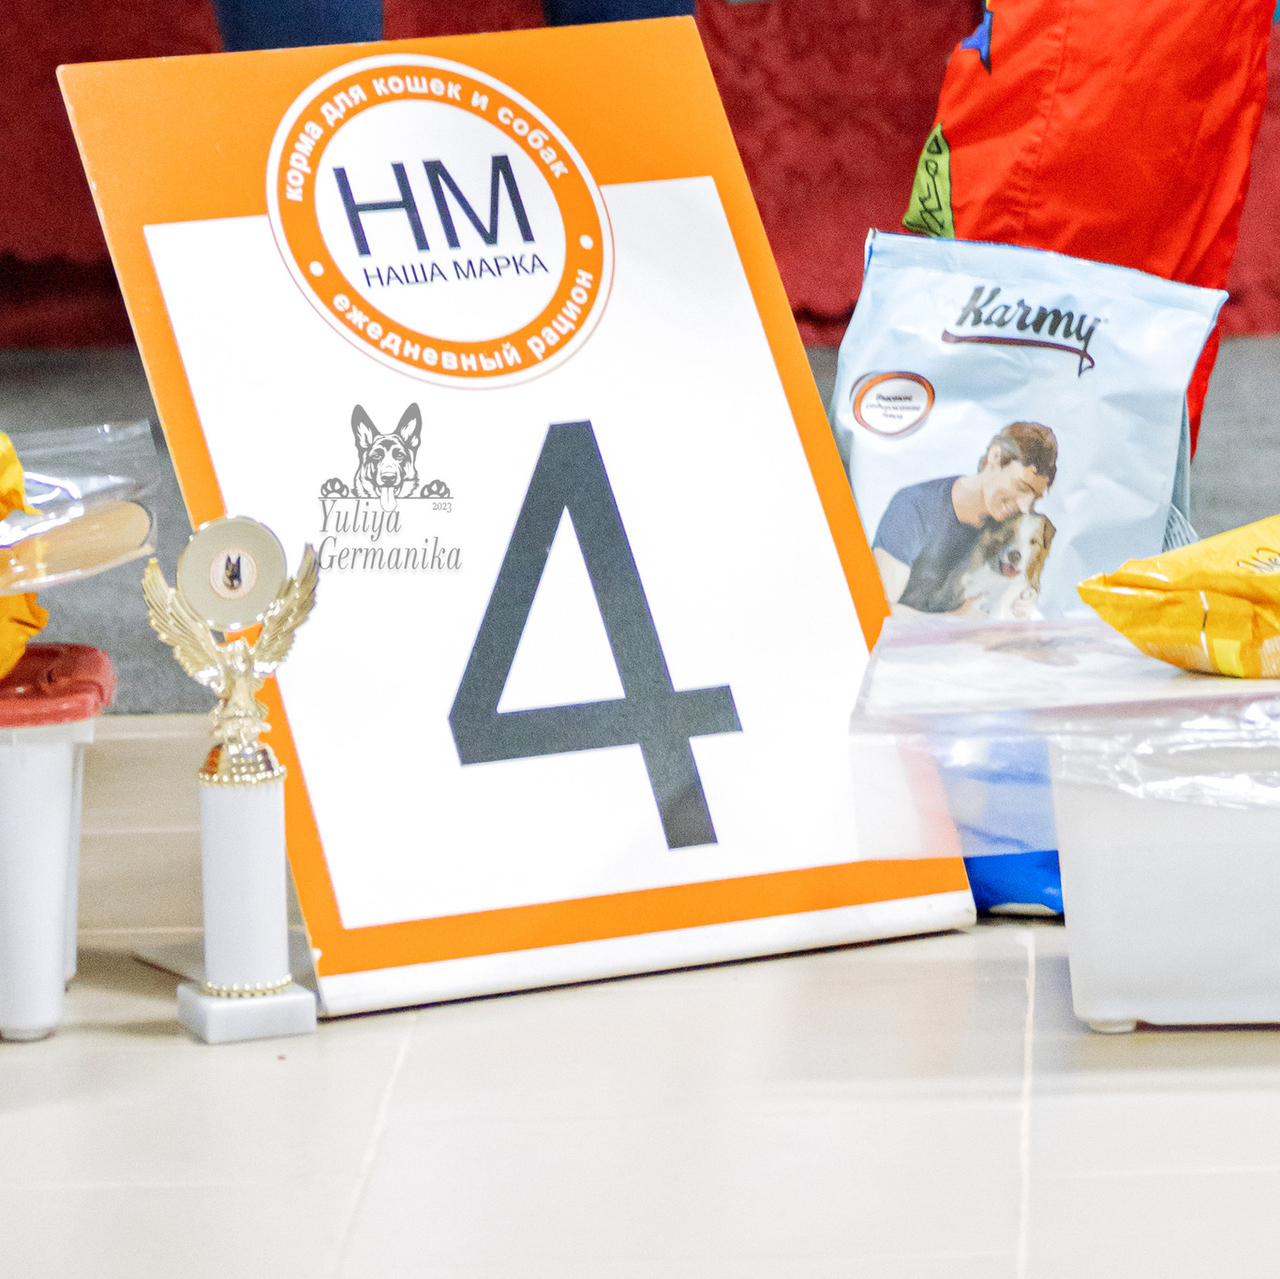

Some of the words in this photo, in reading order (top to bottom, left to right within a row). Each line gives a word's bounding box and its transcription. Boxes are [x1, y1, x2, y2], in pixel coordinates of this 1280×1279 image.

[285, 121, 323, 201] корма
[322, 82, 367, 127] для
[372, 75, 462, 101] кошек
[471, 90, 490, 111] и
[497, 106, 569, 180] собак
[333, 154, 534, 256] НМ
[332, 291, 522, 373] ежедневный
[527, 270, 594, 361] рацион
[363, 262, 447, 288] НАША
[454, 254, 548, 280] МАРКА
[956, 285, 1102, 378] Karmy
[448, 419, 744, 852] 4
